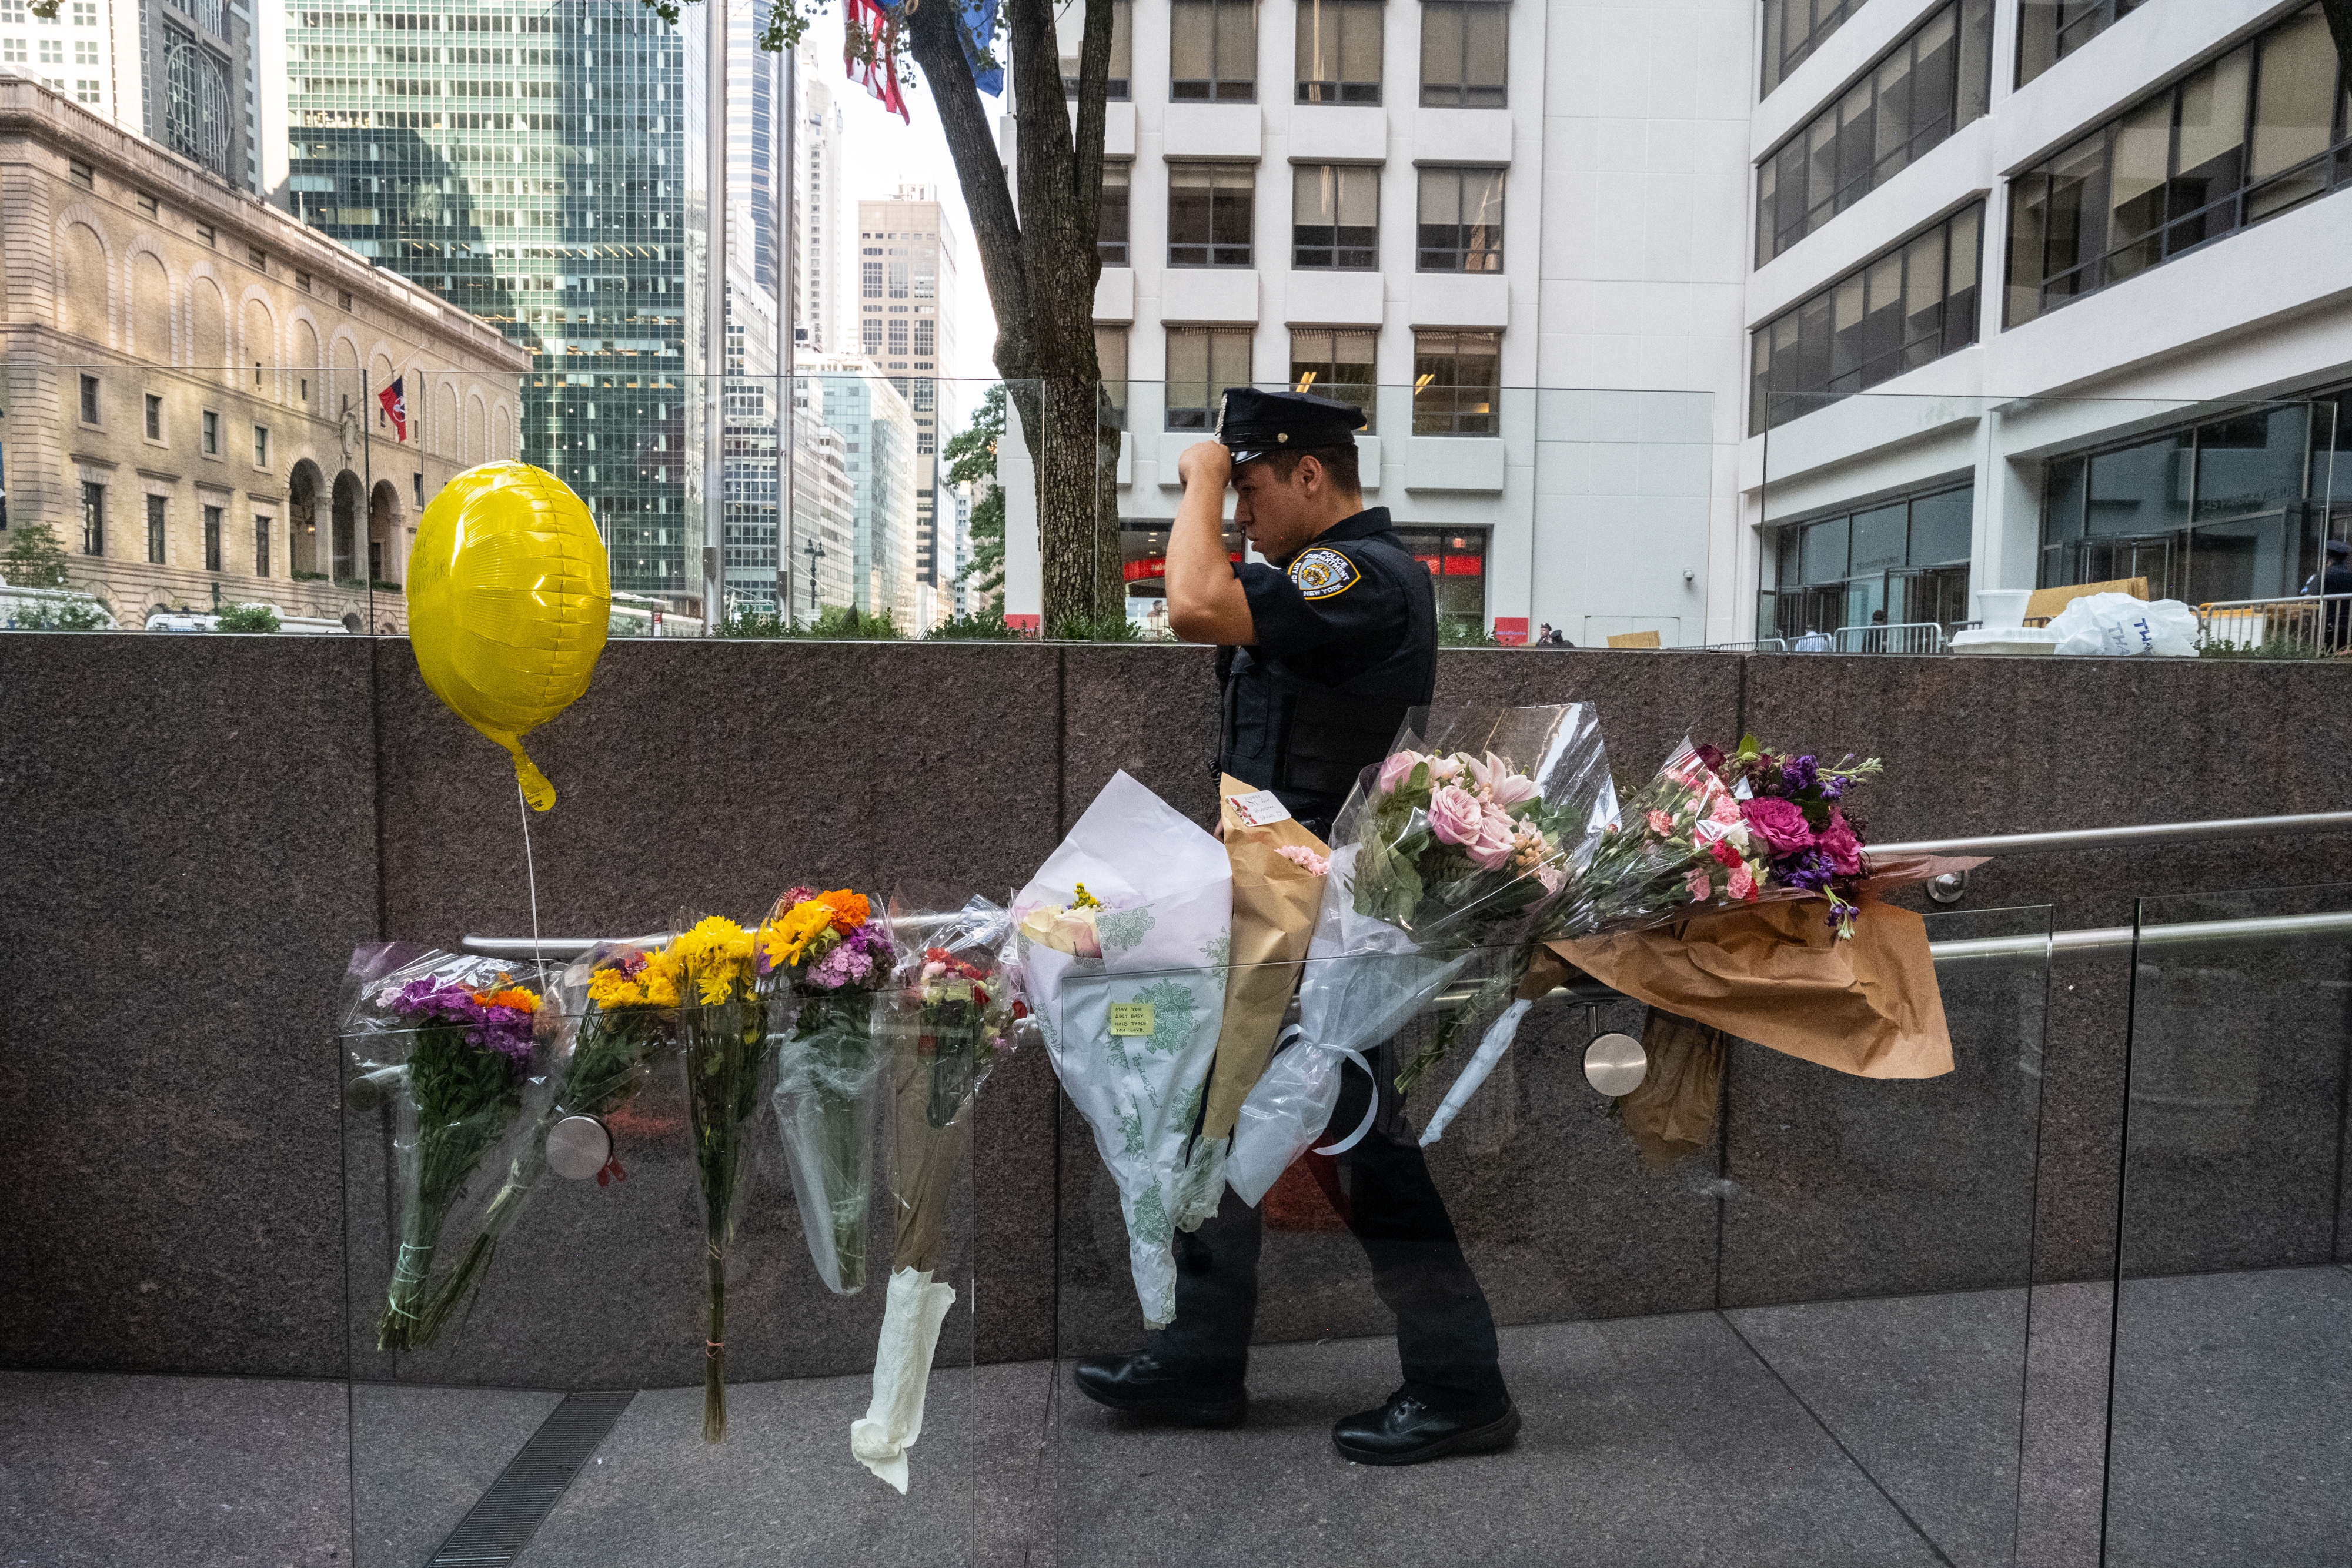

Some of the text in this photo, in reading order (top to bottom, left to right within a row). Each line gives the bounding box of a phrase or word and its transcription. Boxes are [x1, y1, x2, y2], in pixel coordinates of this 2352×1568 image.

[1305, 553, 1350, 581] DEPARTMENT
[1320, 550, 1348, 569] POLICE
[1291, 562, 1302, 584] CITY OF
[1321, 583, 1344, 594] YORK
